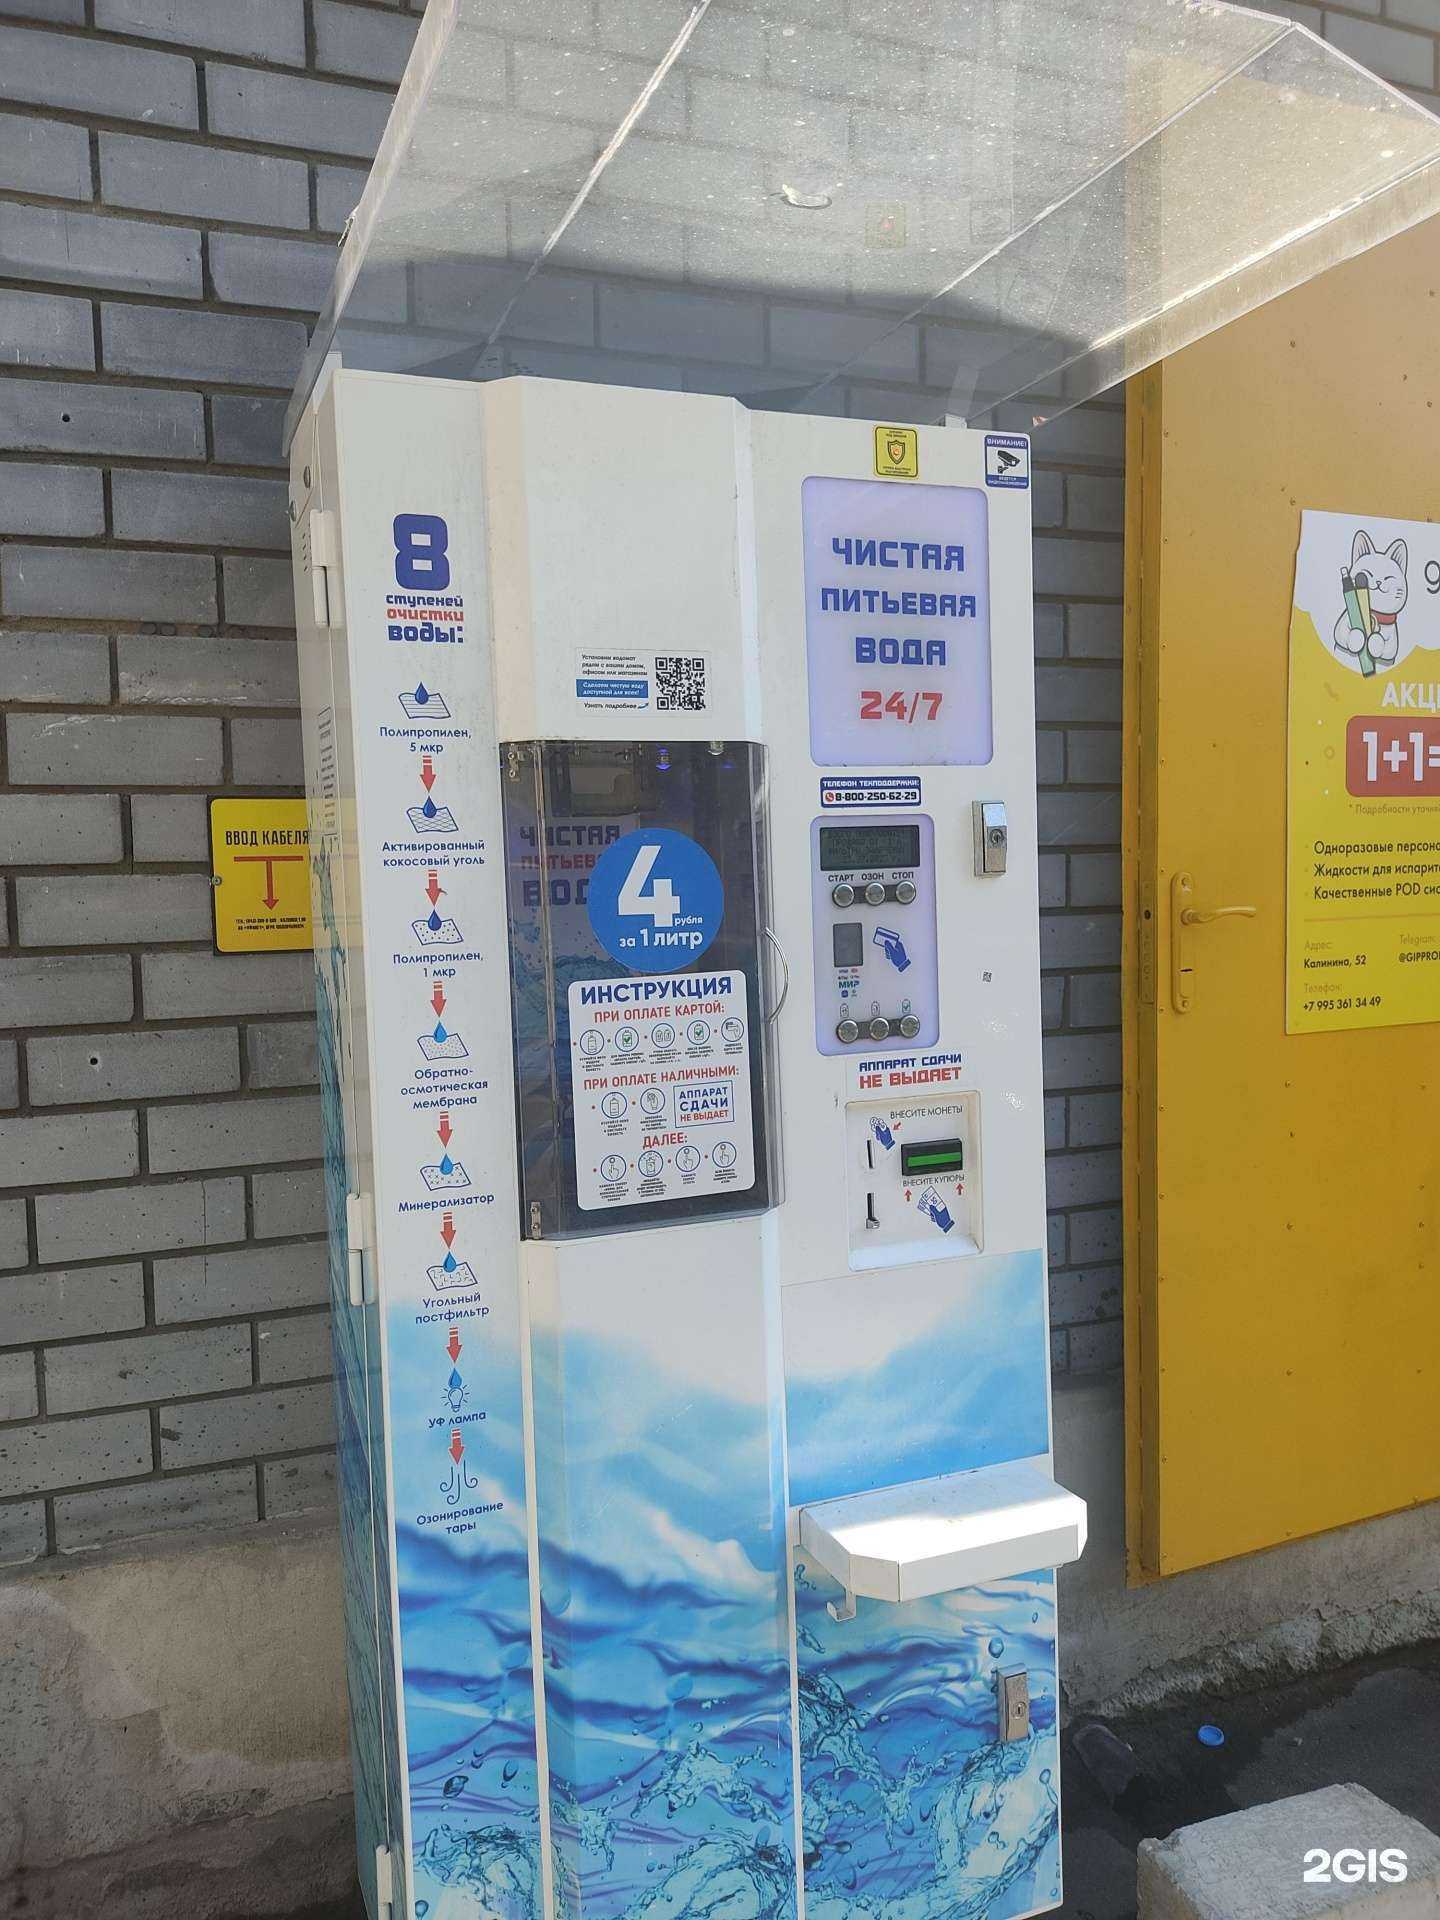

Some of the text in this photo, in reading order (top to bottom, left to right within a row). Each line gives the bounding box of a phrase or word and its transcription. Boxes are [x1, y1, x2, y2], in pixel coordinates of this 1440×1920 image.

[393, 513, 450, 591] 8
[832, 537, 964, 571] ЧИСТАЯ
[386, 594, 464, 607] ступеней
[821, 587, 976, 617] ПИТЬЕВАЯ
[387, 608, 464, 622] очистки
[388, 622, 464, 643] воды:
[855, 637, 946, 666] ВОДА
[1382, 682, 1440, 714] АКЦ
[860, 691, 943, 723] 24/7
[380, 727, 472, 739] Полипропилен,
[410, 743, 444, 754] 5 мкр
[823, 780, 857, 788] ТЕЛЕФОН
[225, 830, 309, 846] ВВОД КАБЕЛЯ
[382, 839, 485, 853] Активированный
[1314, 840, 1394, 857] Одноразовые
[383, 855, 485, 867] кокосовый уголь
[828, 873, 854, 882] СТАРТ
[861, 872, 884, 880] ОЗОН
[892, 871, 914, 880] СТОП
[1314, 863, 1370, 878] Жидкости
[1372, 865, 1392, 876] для
[618, 845, 681, 927] 4
[1314, 886, 1393, 900] Качественные
[1396, 883, 1421, 896] POD
[675, 914, 703, 925] рубля
[620, 928, 703, 950] за 1 литр
[1304, 955, 1367, 969] Калинина, 52
[1399, 951, 1440, 962] @GIPPRO
[432, 967, 456, 978] мкр
[581, 977, 732, 1005] ИНСТРУКЦИЯ
[838, 980, 860, 988] МИР
[1304, 996, 1381, 1011] +7 995 361 34 49
[594, 1000, 725, 1023] ПРИ ОПЛАТЕ КАРТОЙ:
[859, 1054, 962, 1072] АППАРАТ СДАЧИ
[414, 1068, 473, 1080] Обратно-
[583, 1066, 739, 1090] ПРИ ОПЛАТЕ НАЛИЧНЫМИ:
[860, 1067, 962, 1089] НЕ ВЫДАЕТ
[400, 1080, 488, 1095] осмотическая
[679, 1087, 728, 1099] АППАРАТ
[413, 1096, 477, 1110] мембрана
[680, 1097, 728, 1111] СДАЧИ
[680, 1110, 728, 1122] НЕ ВЫДАЕТ
[890, 1106, 963, 1119] ВНЕСИТЕ МОНЕТЫ
[642, 1132, 688, 1150] ДАЛЕЕ:
[903, 1178, 933, 1187] ВНЕСИТЕ
[398, 1194, 495, 1212] Минерализатор
[422, 1292, 481, 1309] Угольный
[415, 1307, 489, 1324] постфильтр
[449, 1412, 487, 1425] лампа
[416, 1502, 504, 1525] Озонирование
[446, 1522, 476, 1534] тары
